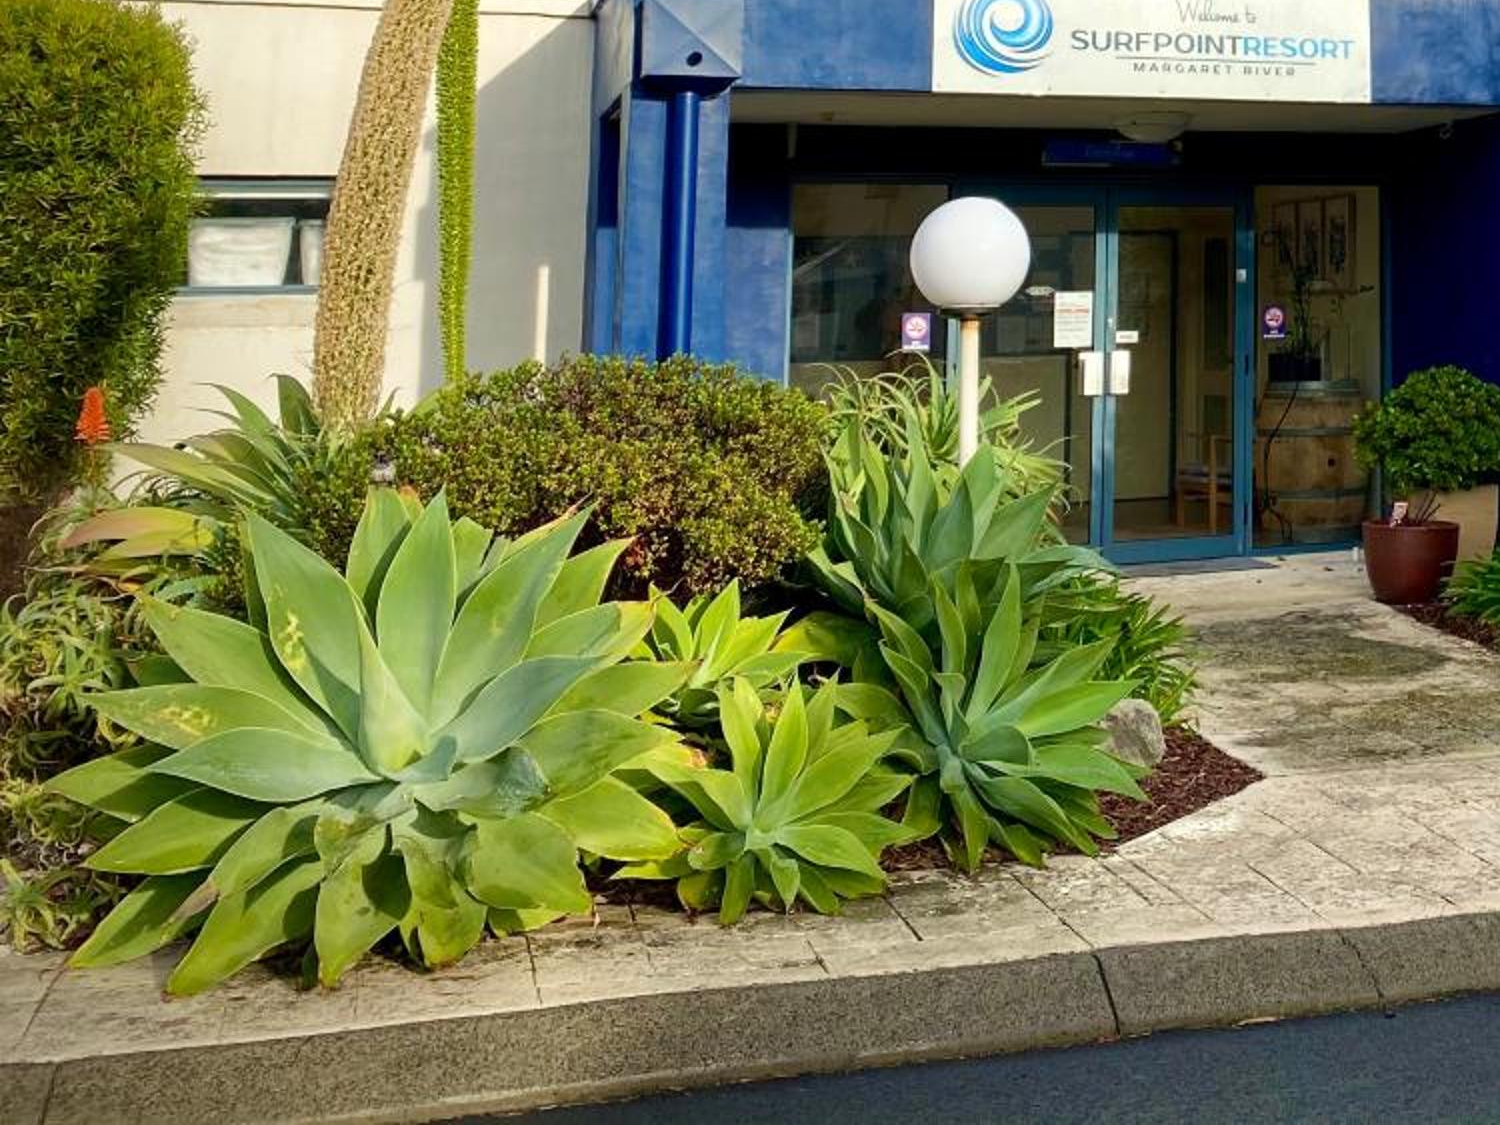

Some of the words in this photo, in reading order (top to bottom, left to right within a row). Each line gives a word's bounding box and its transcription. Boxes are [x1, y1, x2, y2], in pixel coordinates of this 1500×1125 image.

[1245, 4, 1257, 24] to
[1071, 29, 1356, 60] SURFPOINTRESORT
[1133, 62, 1232, 76] MARGARET
[1243, 66, 1296, 77] RIVER
